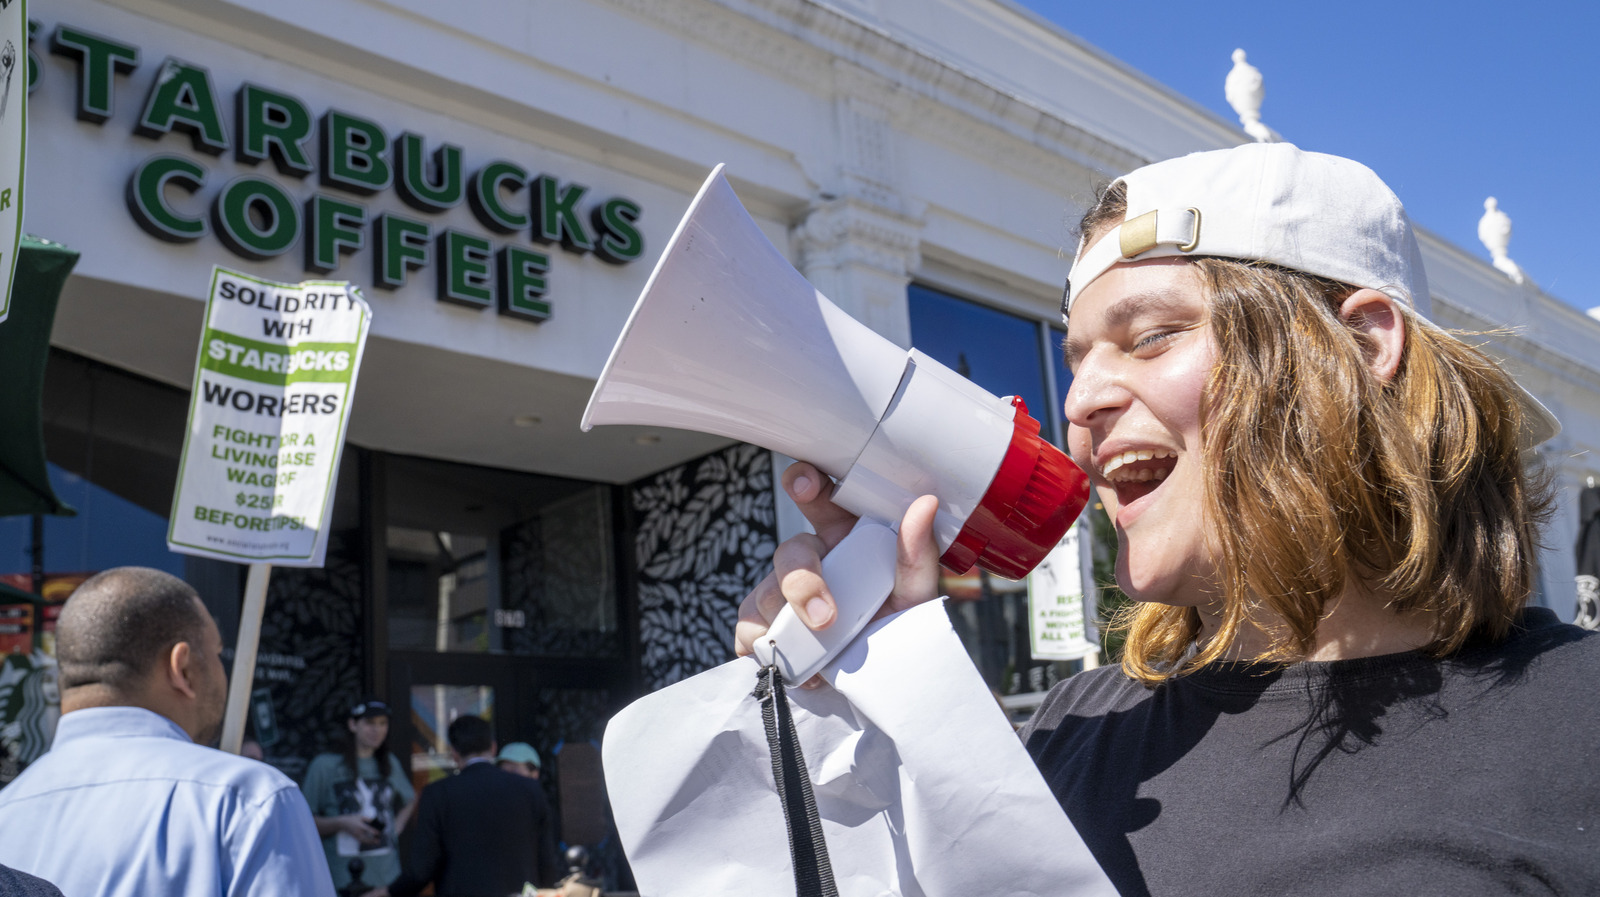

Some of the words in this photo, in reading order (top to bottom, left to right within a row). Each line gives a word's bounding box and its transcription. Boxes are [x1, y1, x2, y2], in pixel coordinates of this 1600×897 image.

[126, 154, 552, 322] COFFEE
[213, 425, 277, 449] FIGHT
[304, 432, 315, 446] A
[194, 506, 271, 532] BEFORE
